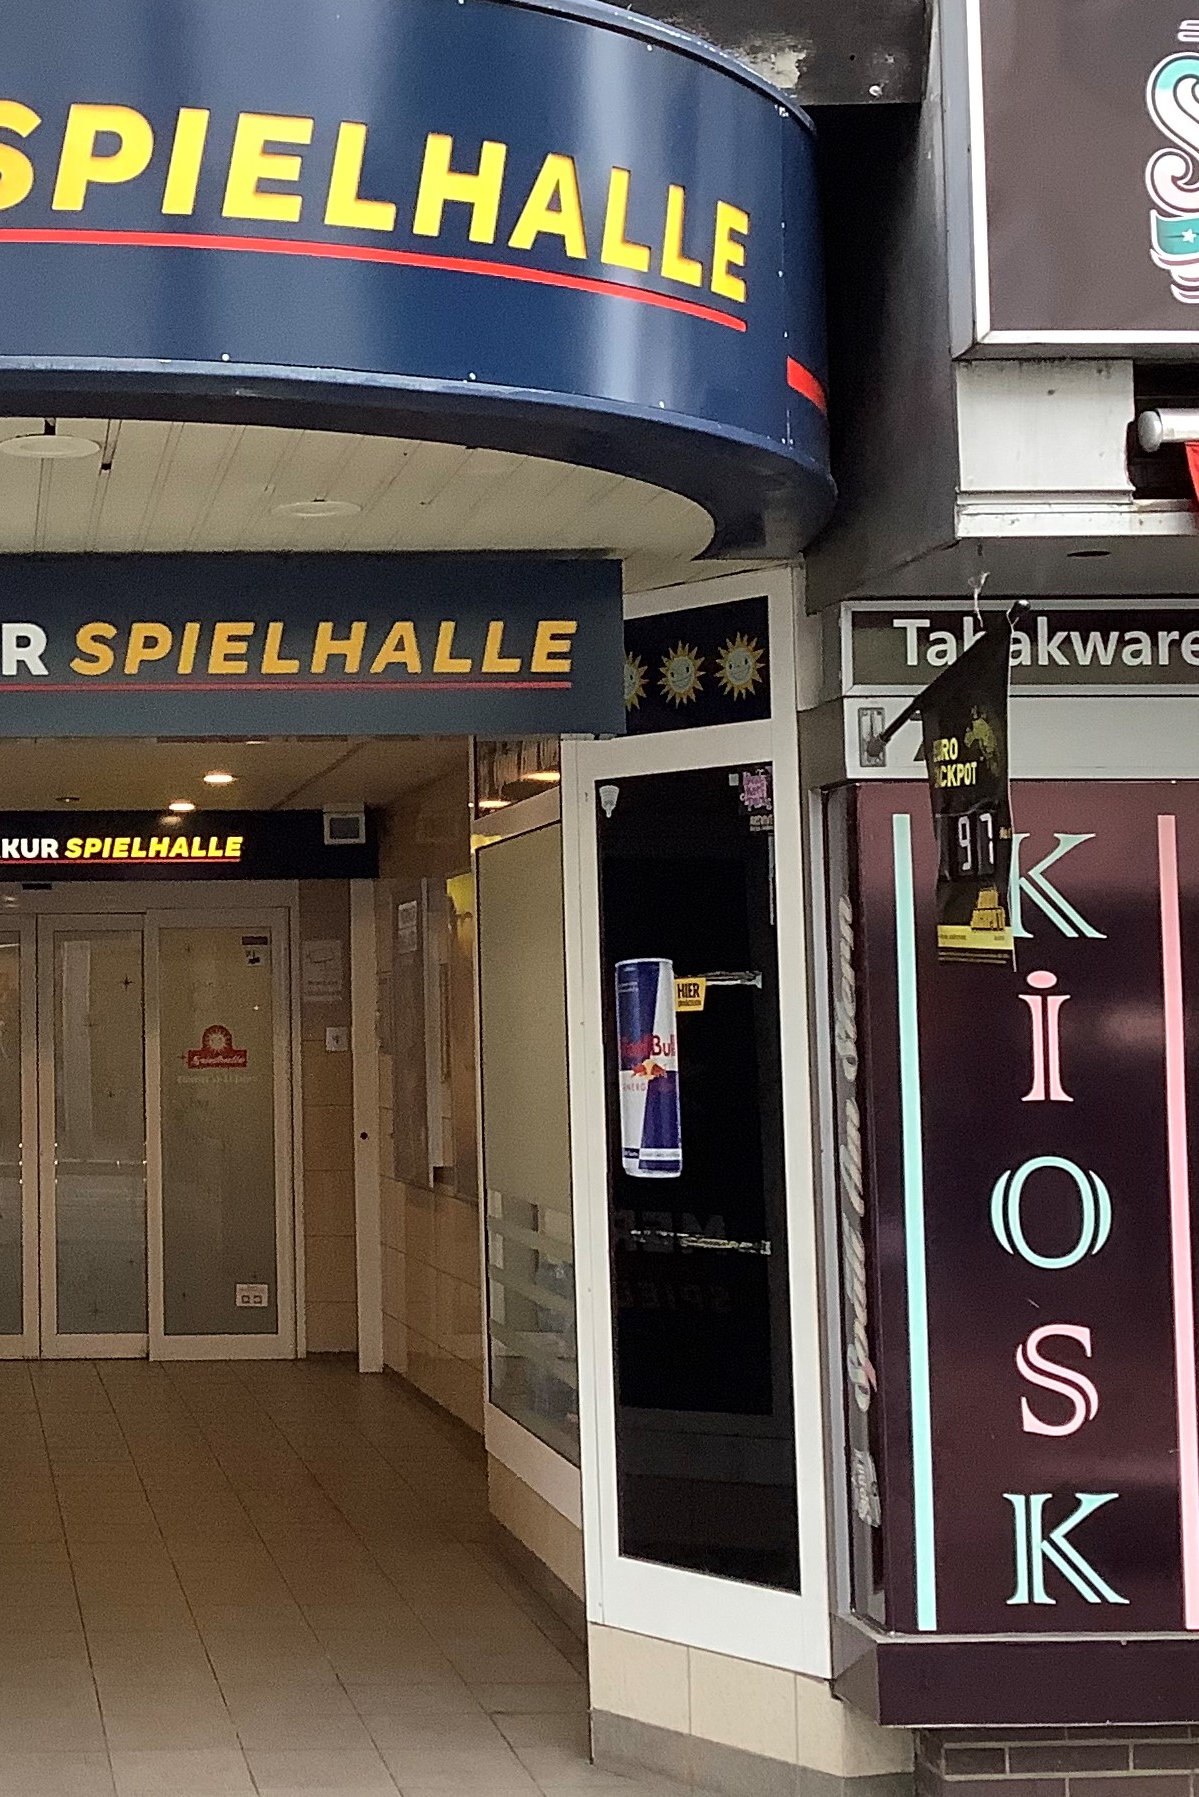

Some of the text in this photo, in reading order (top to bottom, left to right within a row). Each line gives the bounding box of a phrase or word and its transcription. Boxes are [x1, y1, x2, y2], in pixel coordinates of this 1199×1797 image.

[69, 619, 578, 676] SPIELHALLE
[934, 761, 977, 788] CKPOT
[64, 836, 244, 859] SPIELHALLE
[677, 983, 700, 999] HIER
